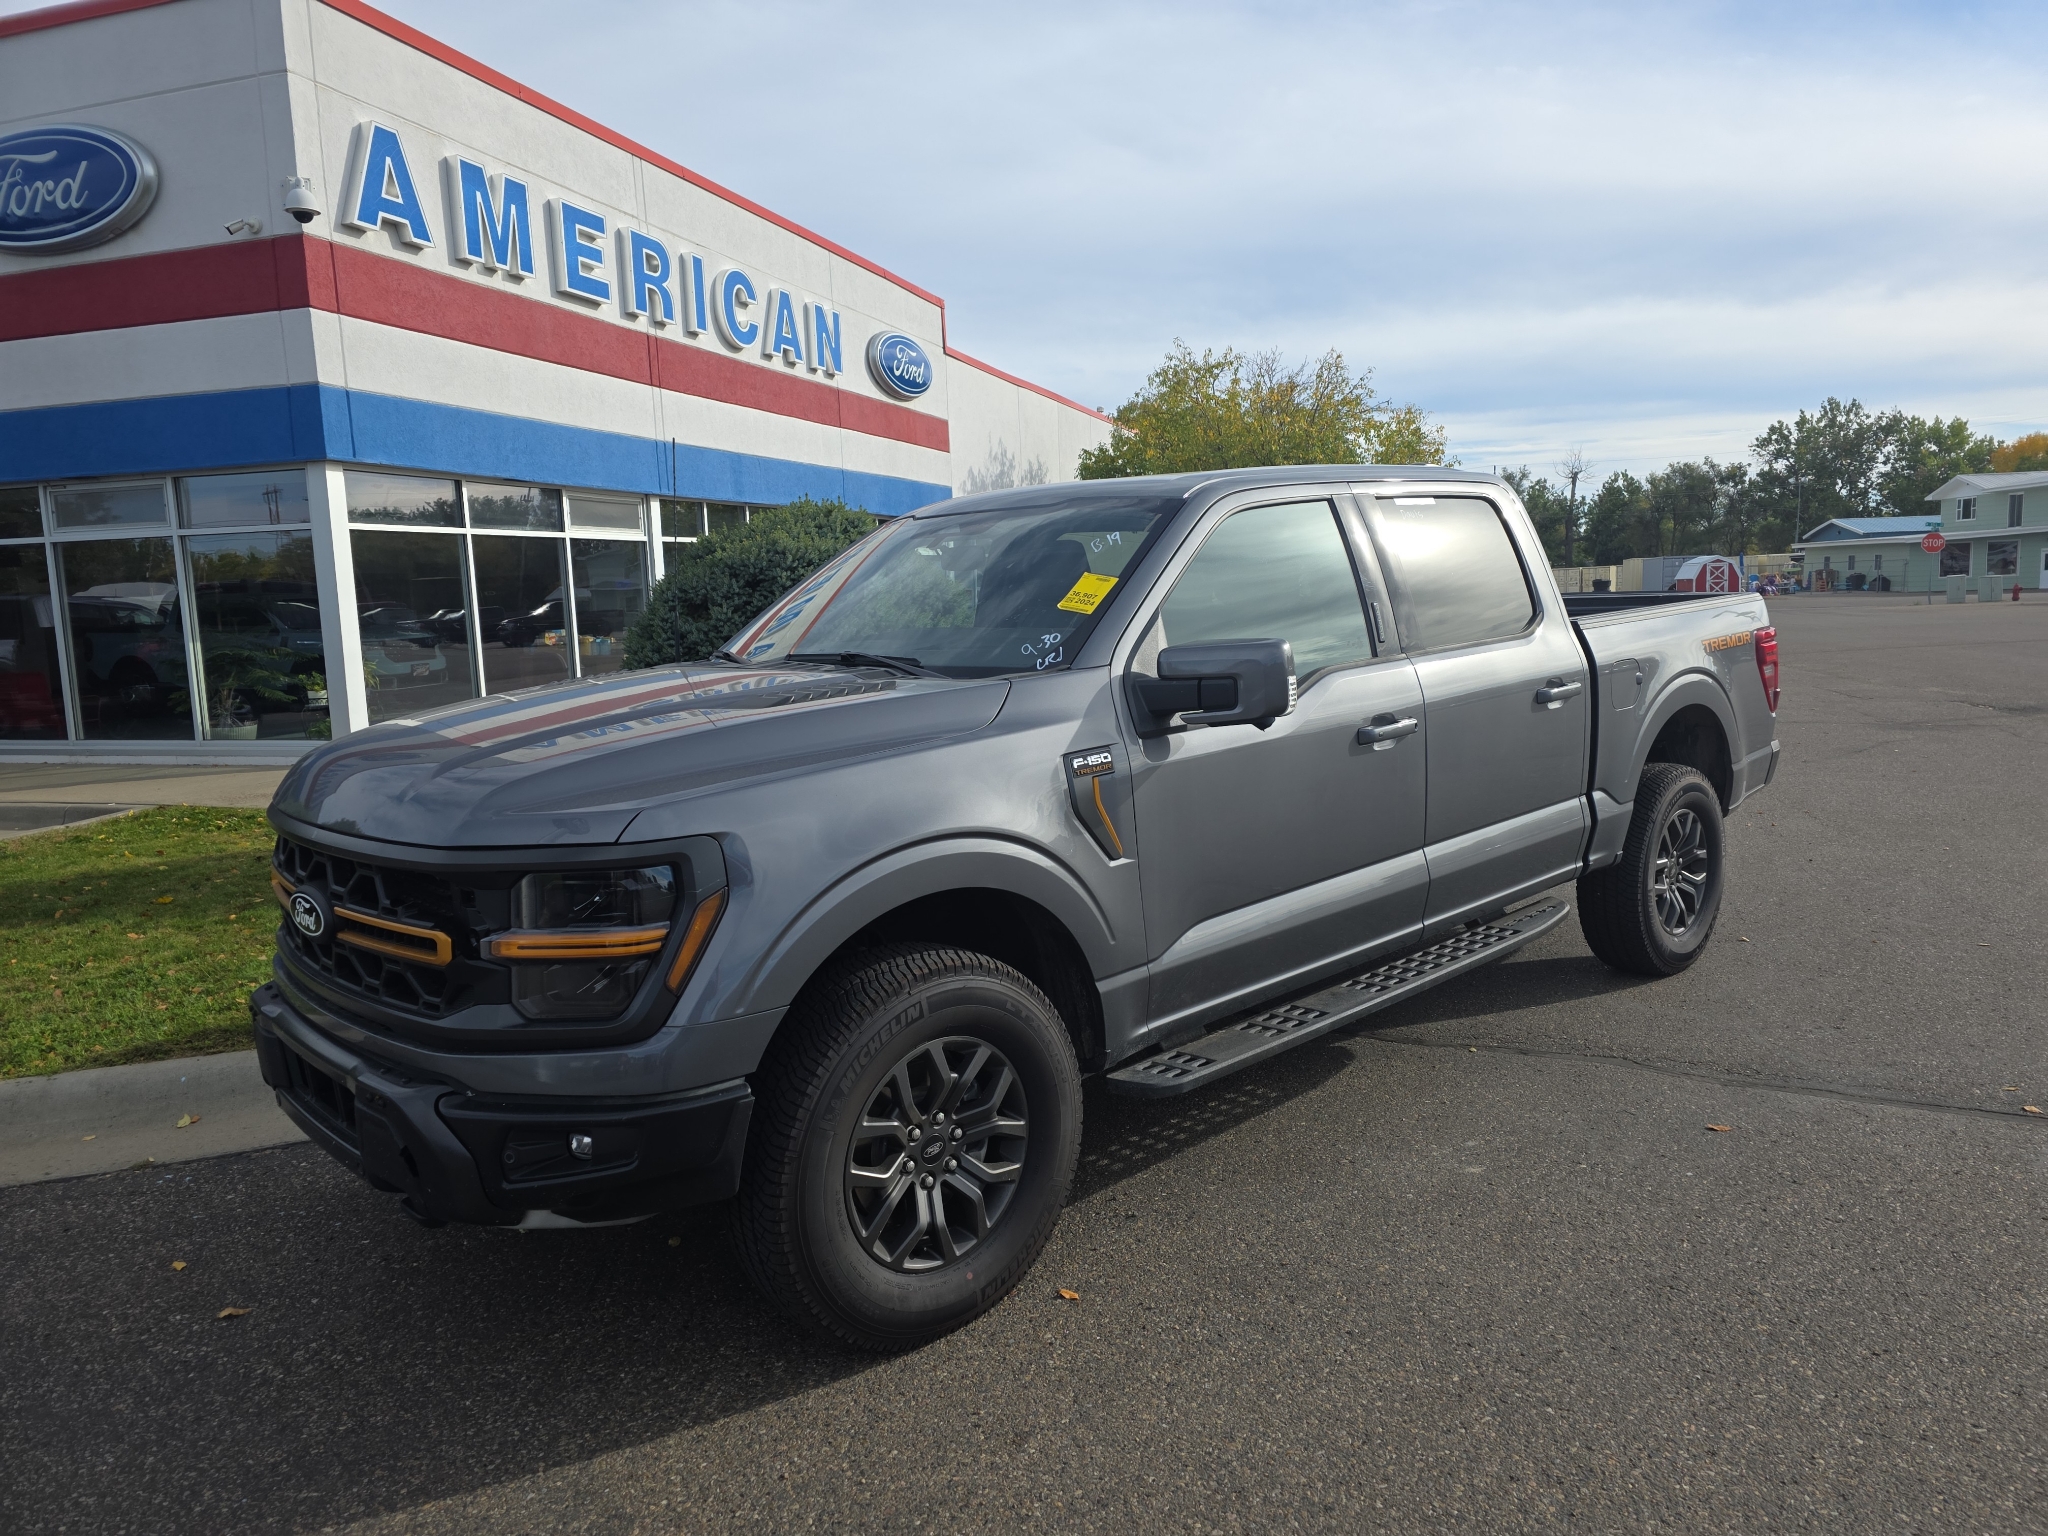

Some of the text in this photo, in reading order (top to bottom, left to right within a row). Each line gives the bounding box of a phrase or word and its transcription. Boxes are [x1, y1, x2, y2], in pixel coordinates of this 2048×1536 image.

[346, 120, 843, 376] AMERICAN
[893, 344, 925, 385] Ford
[1923, 538, 1944, 547] STOP
[1021, 632, 1061, 655] 9-30
[1702, 631, 1751, 653] TREMOR
[1073, 753, 1112, 768] F-150
[1075, 763, 1112, 775] TREMOR
[295, 898, 316, 931] Ford
[839, 1002, 921, 1095] MICHELIN
[981, 1211, 1052, 1301] MICHELIN
